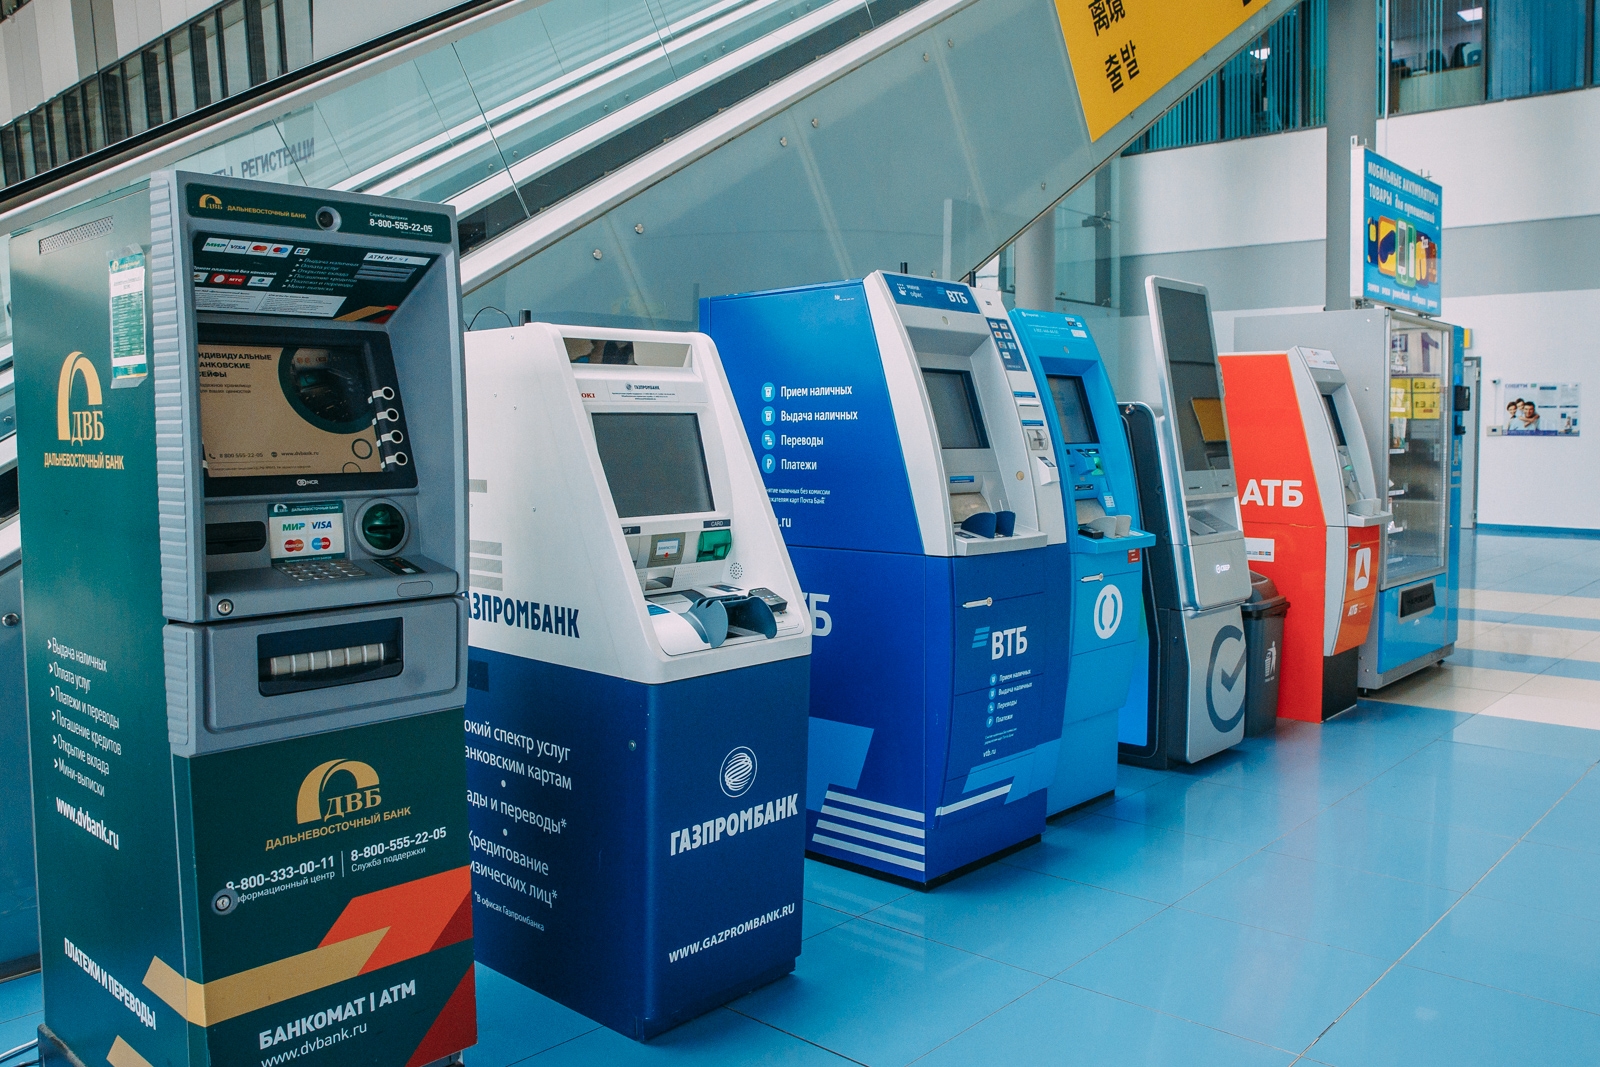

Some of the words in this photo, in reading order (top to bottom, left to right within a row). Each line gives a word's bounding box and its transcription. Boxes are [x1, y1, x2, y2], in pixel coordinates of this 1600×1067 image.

[227, 205, 289, 217] ДАЛЬНЕВОСТОЧНЫЙ
[1369, 183, 1392, 206] ТОВАРЫ
[369, 218, 433, 233] 8-800-555-22-05
[946, 290, 969, 304] ВТБ
[781, 386, 808, 400] Прием
[810, 386, 853, 396] наличных
[71, 410, 105, 447] ДВБ
[781, 410, 813, 423] Выдача
[814, 411, 858, 421] наличных
[781, 435, 824, 448] Переводы
[44, 451, 104, 469] ДАЛЬНЕВОСТОЧНЫЙ
[105, 454, 124, 469] БАНК
[781, 459, 818, 470] Платежи
[1240, 479, 1304, 507] АТБ
[282, 522, 306, 531] МИР
[311, 521, 332, 529] VISA
[801, 592, 832, 637] Б
[52, 637, 75, 661] Выдача
[76, 649, 108, 672] наличных
[991, 625, 1028, 660] ВТБ
[54, 661, 74, 685] Оплата
[75, 673, 91, 694] услуг
[55, 685, 81, 706] Платежи
[82, 700, 86, 715] и
[87, 703, 119, 729] переводы
[56, 709, 90, 741] Погашение
[91, 729, 122, 756] кредитов
[493, 727, 534, 751] спектр
[536, 739, 571, 764] услуг
[58, 733, 86, 763] Открытие
[86, 752, 109, 776] вклада
[58, 757, 105, 797] Мини-выписки
[527, 763, 572, 791] картам
[324, 787, 382, 822] ДВБ
[466, 789, 488, 808] ады
[490, 798, 498, 812] и
[56, 797, 119, 850] www.dvbank.ru
[265, 812, 381, 851] ДАЛЬНЕВОСТОЧНЫЙ
[383, 806, 411, 822] БАНК
[670, 793, 798, 856] ГАЗПРОМБАНК
[350, 826, 447, 862] 8-800-555-22-05
[351, 857, 382, 873] Служба
[383, 846, 426, 866] поддержки
[226, 855, 334, 892] 8-800-333-00-11
[310, 871, 335, 884] центр
[481, 897, 502, 913] офисах
[502, 905, 545, 932] Газпромбанка
[669, 903, 795, 963] WWW.GAZPROMBANK.RU
[64, 937, 101, 983] ПЛАТЕЖИ
[101, 968, 108, 990] И
[108, 974, 156, 1031] ПЕРЕВОДЫ
[259, 996, 366, 1050] БАНКОМАТ
[379, 979, 416, 1008] ATM
[261, 1022, 367, 1067] www.dvbank.ru
